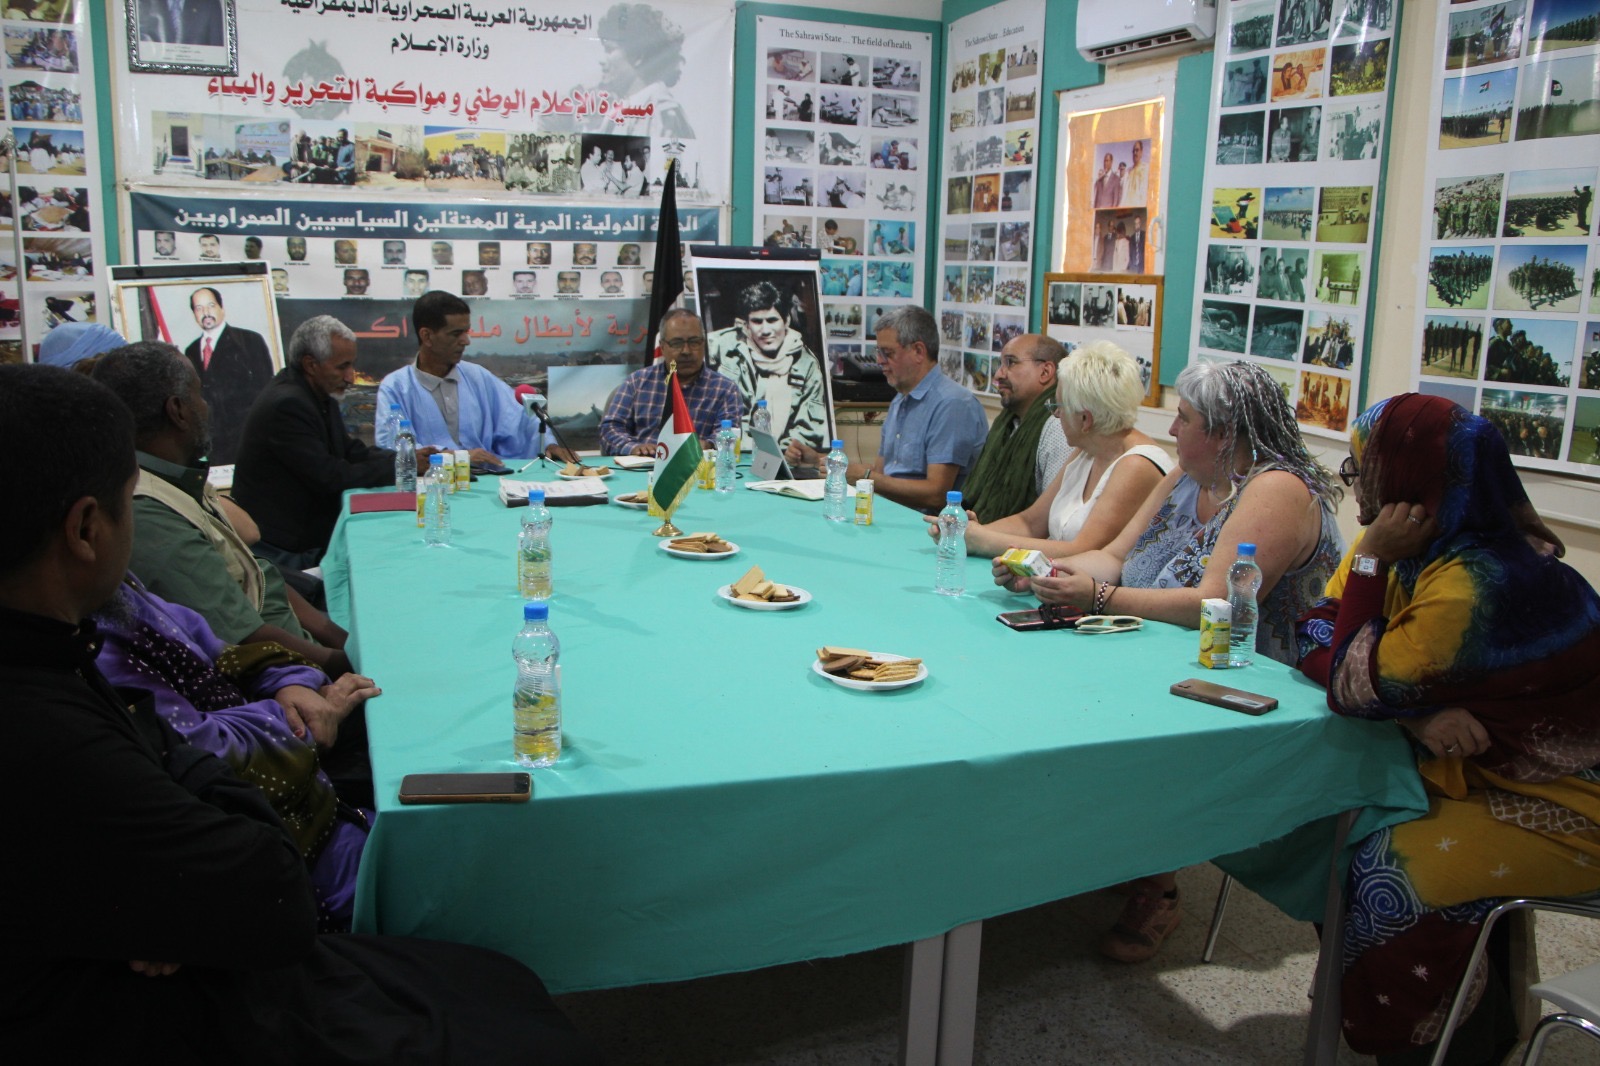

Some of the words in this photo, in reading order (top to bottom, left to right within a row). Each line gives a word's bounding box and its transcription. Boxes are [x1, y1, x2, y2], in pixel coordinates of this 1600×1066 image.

[382, 0, 461, 22] الصحراوية
[463, 3, 516, 28] العربية
[519, 7, 592, 35] الجمهورية
[456, 35, 490, 59] وزارة
[779, 29, 794, 38] The
[795, 30, 824, 41] Sahrawi
[825, 33, 842, 42] State
[851, 36, 867, 45] The
[867, 36, 882, 47] field
[883, 39, 891, 47] of
[891, 39, 912, 50] health
[279, 76, 361, 106] التحرير
[365, 77, 447, 112] مواكبة
[465, 86, 526, 122] الوطني
[530, 88, 595, 120] الإعلام
[599, 91, 654, 123] مسيرة
[174, 206, 291, 229] الصحراويين
[296, 209, 409, 231] السياسيين
[413, 210, 508, 232] للمعتقلين
[514, 212, 571, 234] الحرية
[514, 308, 593, 346] لأبطال
